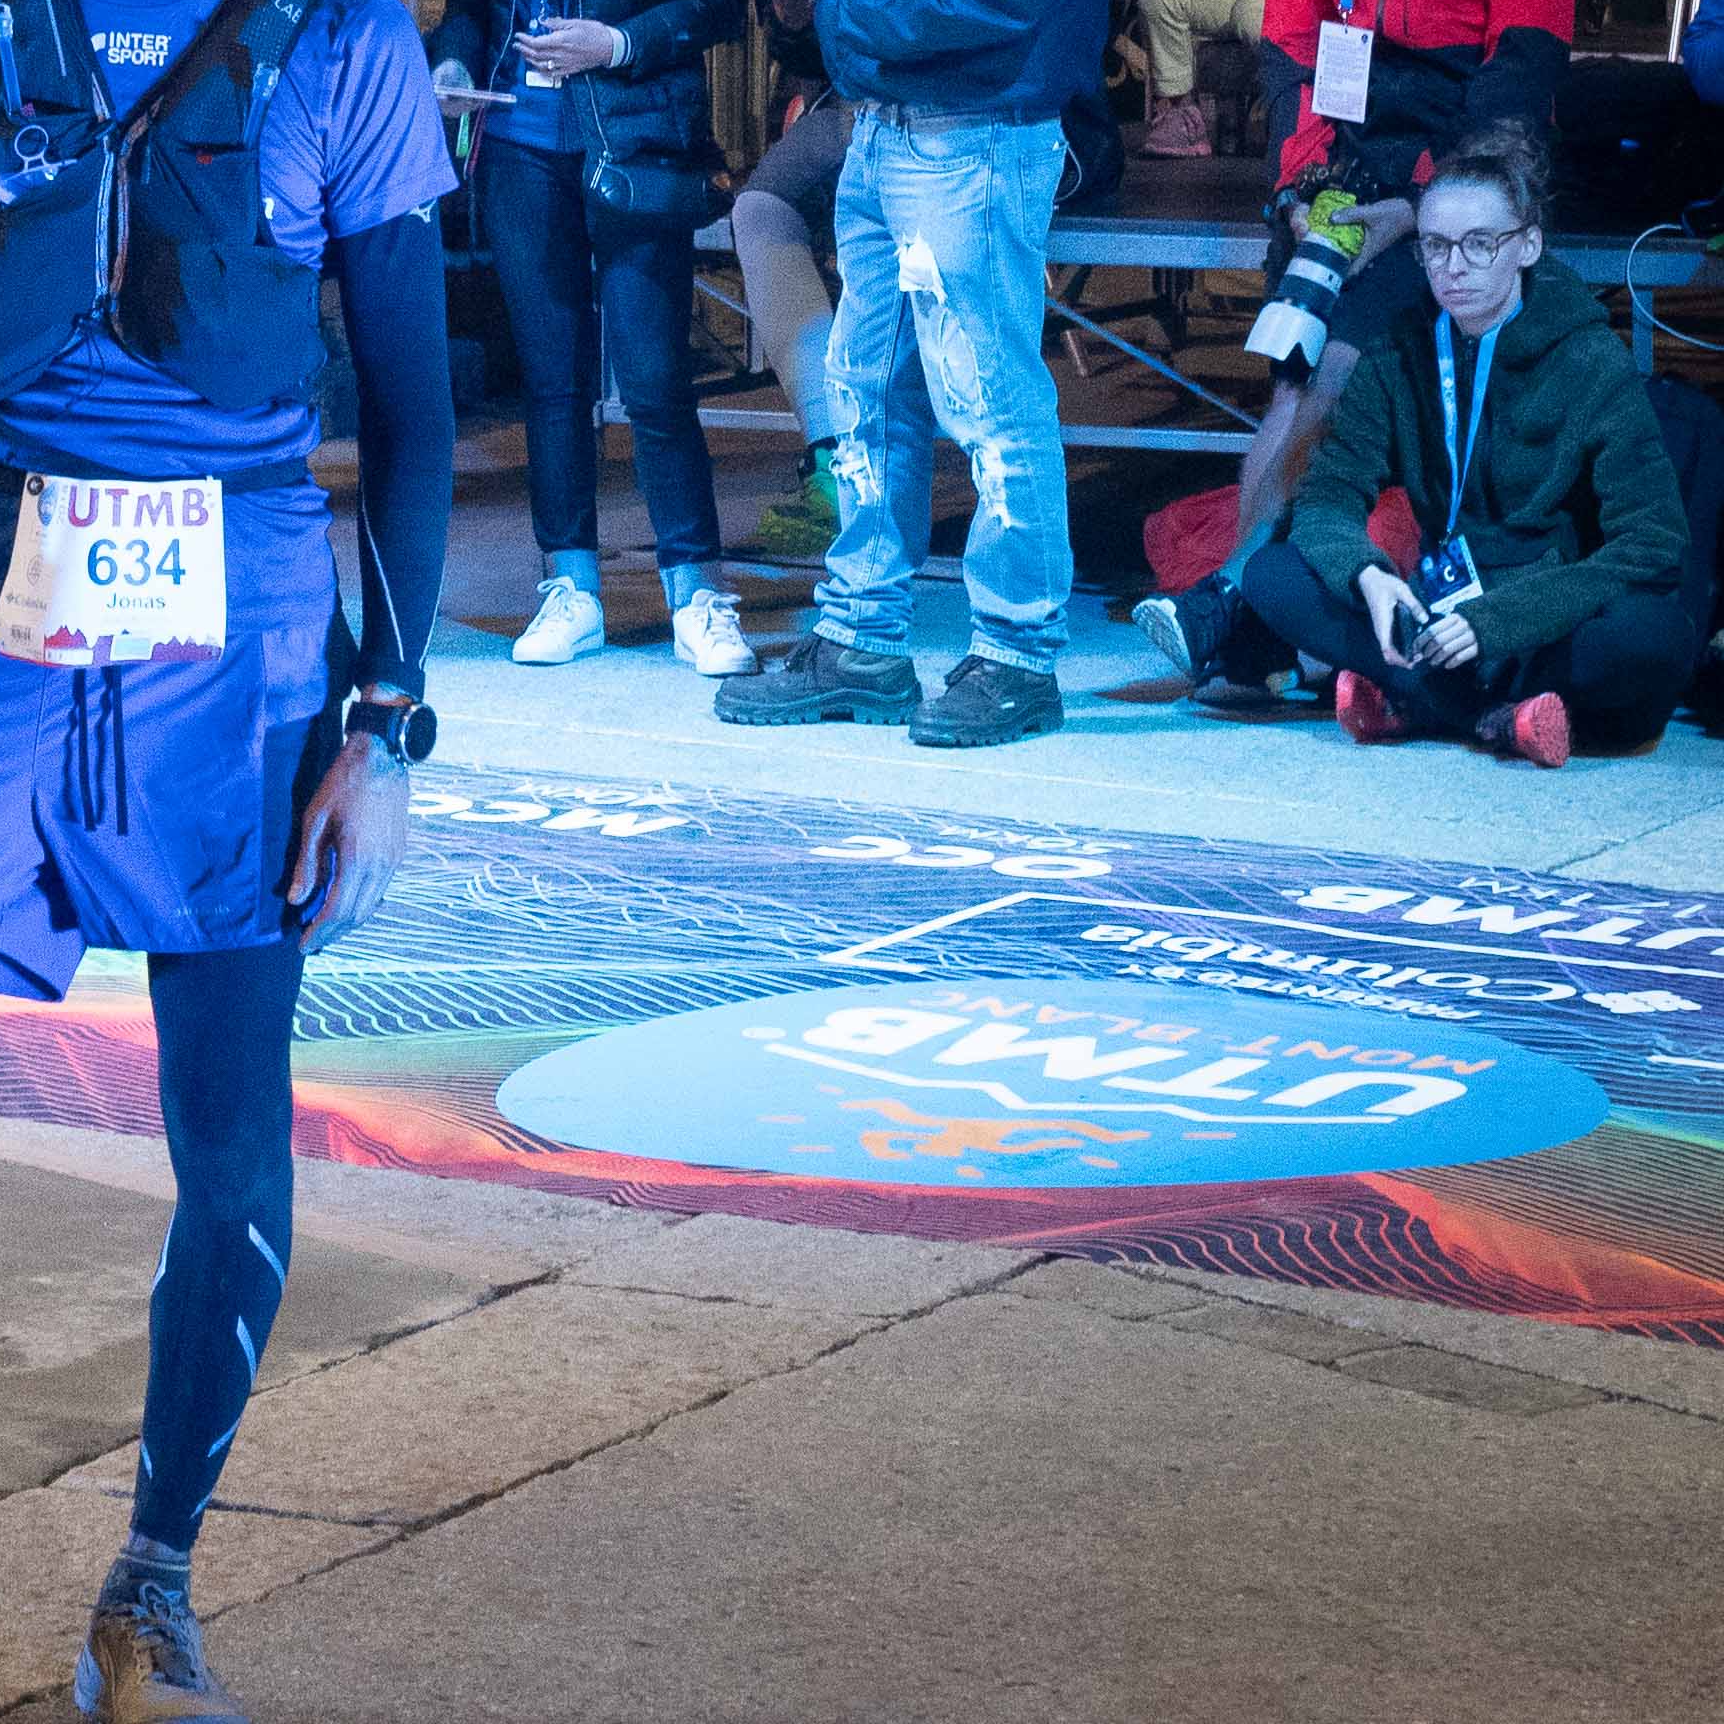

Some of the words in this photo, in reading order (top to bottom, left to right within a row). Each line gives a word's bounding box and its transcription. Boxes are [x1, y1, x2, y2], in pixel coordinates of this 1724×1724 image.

[107, 47, 169, 67] SPORT
[108, 31, 169, 52] INTER
[67, 484, 209, 528] UTMB
[87, 538, 186, 586] 634
[106, 592, 167, 610] Jonas
[809, 835, 1113, 879] OCC
[1080, 924, 1577, 1003] Columbia
[1116, 960, 1182, 979] BY
[1198, 970, 1481, 1021] PRESENTED
[908, 991, 1497, 1076] MONT-BLANC
[802, 1006, 1469, 1116] UTMB
